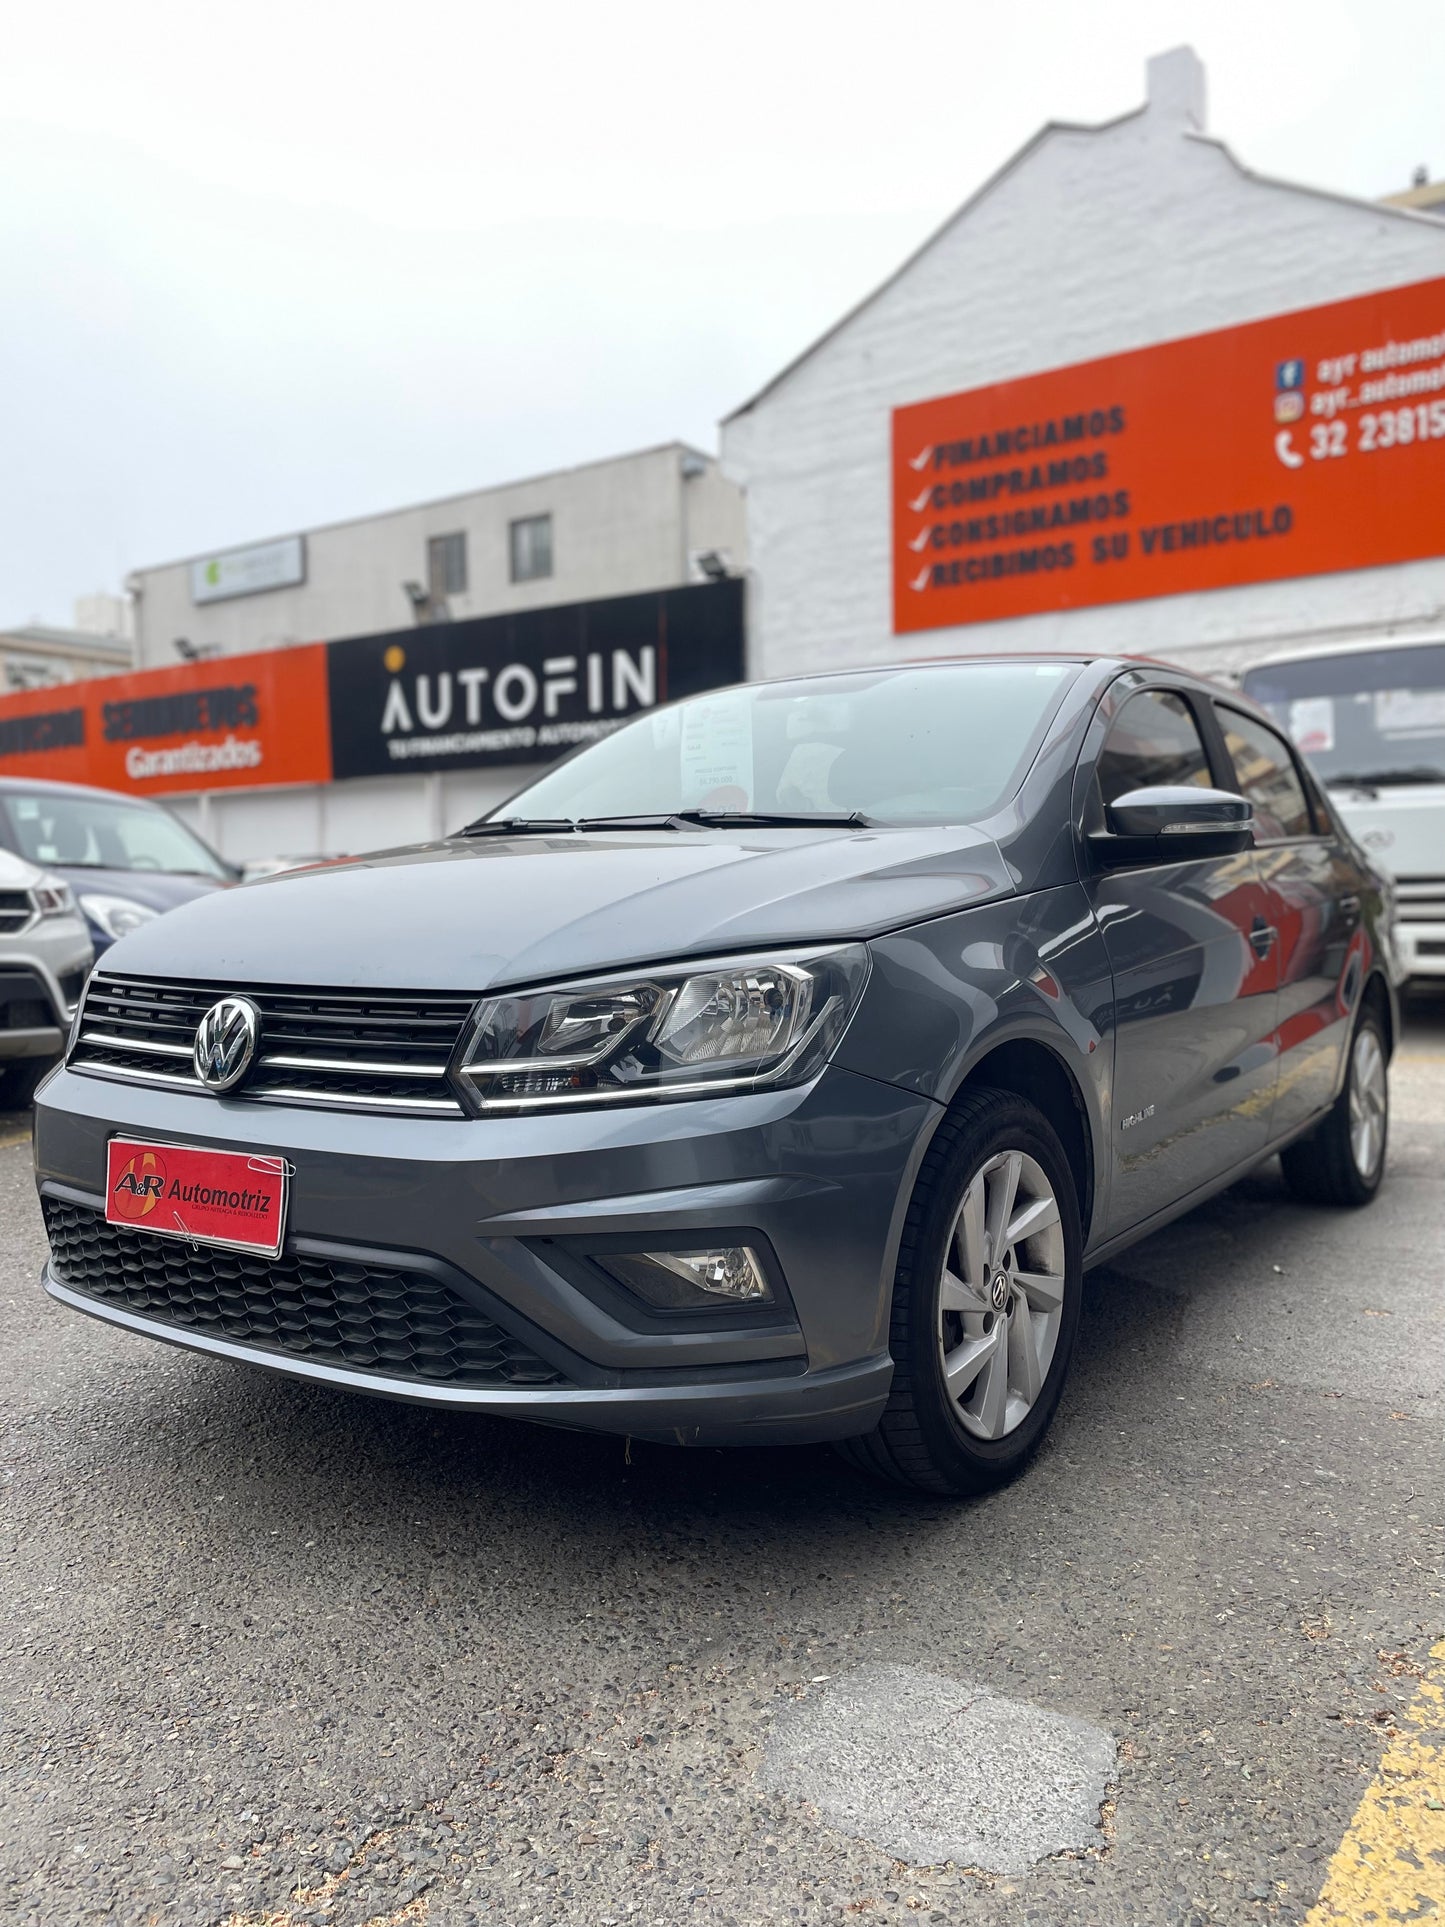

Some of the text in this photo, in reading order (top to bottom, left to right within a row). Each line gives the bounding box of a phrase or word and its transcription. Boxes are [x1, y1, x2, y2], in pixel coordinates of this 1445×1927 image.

[932, 405, 1126, 472] FINANCIAMOS
[1310, 399, 1445, 460] 32 23815
[931, 452, 1108, 510] COMPRAMOS
[931, 491, 1131, 550] CONSIGNAMOS
[931, 505, 1294, 589] RECIBIMOS SU VEHICULO
[380, 646, 656, 734] AUTOFIN
[126, 734, 263, 780] Garantizados
[114, 1171, 272, 1214] A&R Automotriz
